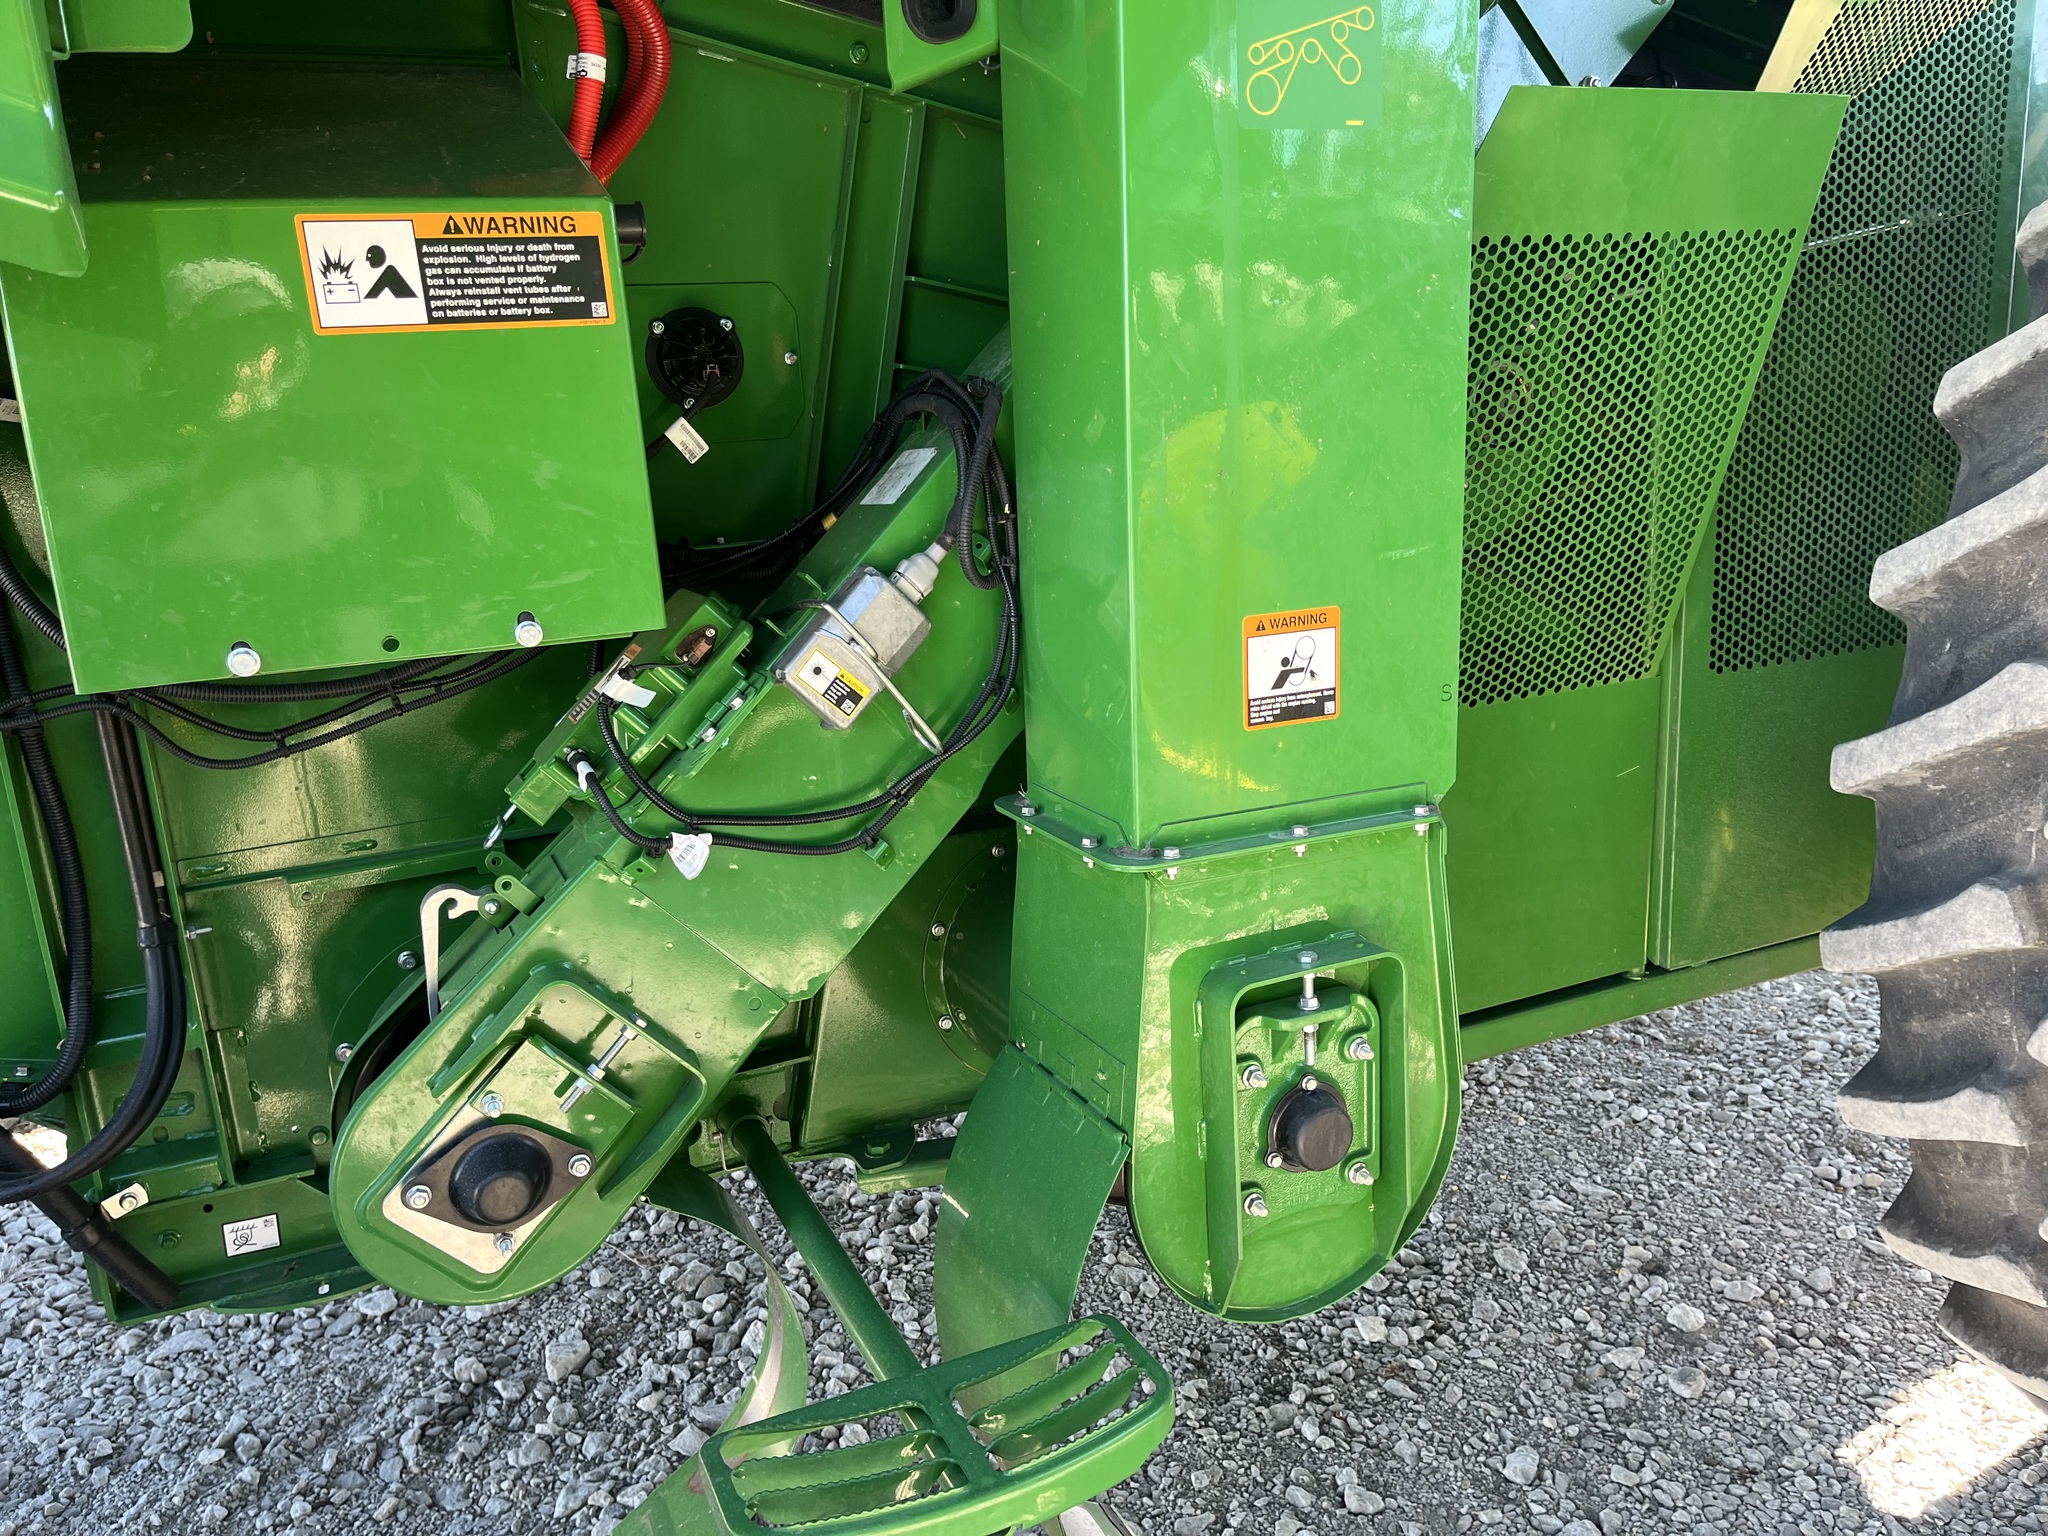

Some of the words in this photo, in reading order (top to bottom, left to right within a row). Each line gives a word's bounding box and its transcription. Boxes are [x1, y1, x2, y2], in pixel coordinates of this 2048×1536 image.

[463, 216, 576, 234] WARNING
[422, 245, 448, 253] Avoid
[451, 244, 485, 252] serious
[487, 244, 513, 253] injury
[527, 243, 552, 251] death
[554, 243, 574, 251] from
[423, 256, 471, 265] explosion.
[476, 255, 497, 263] High
[499, 254, 525, 262] levels
[528, 254, 537, 262] of
[539, 253, 580, 262] hydrogen
[425, 268, 442, 276] gas
[464, 266, 515, 274] accumulate
[517, 265, 524, 273] if
[526, 265, 556, 274] battery
[446, 277, 455, 285] is
[475, 276, 505, 284] vented
[508, 275, 546, 284] properly.
[429, 288, 462, 297] Always
[464, 287, 500, 295] reinstall
[431, 298, 481, 308] performing
[530, 296, 585, 304] maintenance
[447, 309, 486, 317] batteries
[501, 307, 532, 316] battery
[534, 306, 553, 314] box.
[1270, 613, 1327, 629] WARNING
[844, 677, 864, 693] CAUTION
